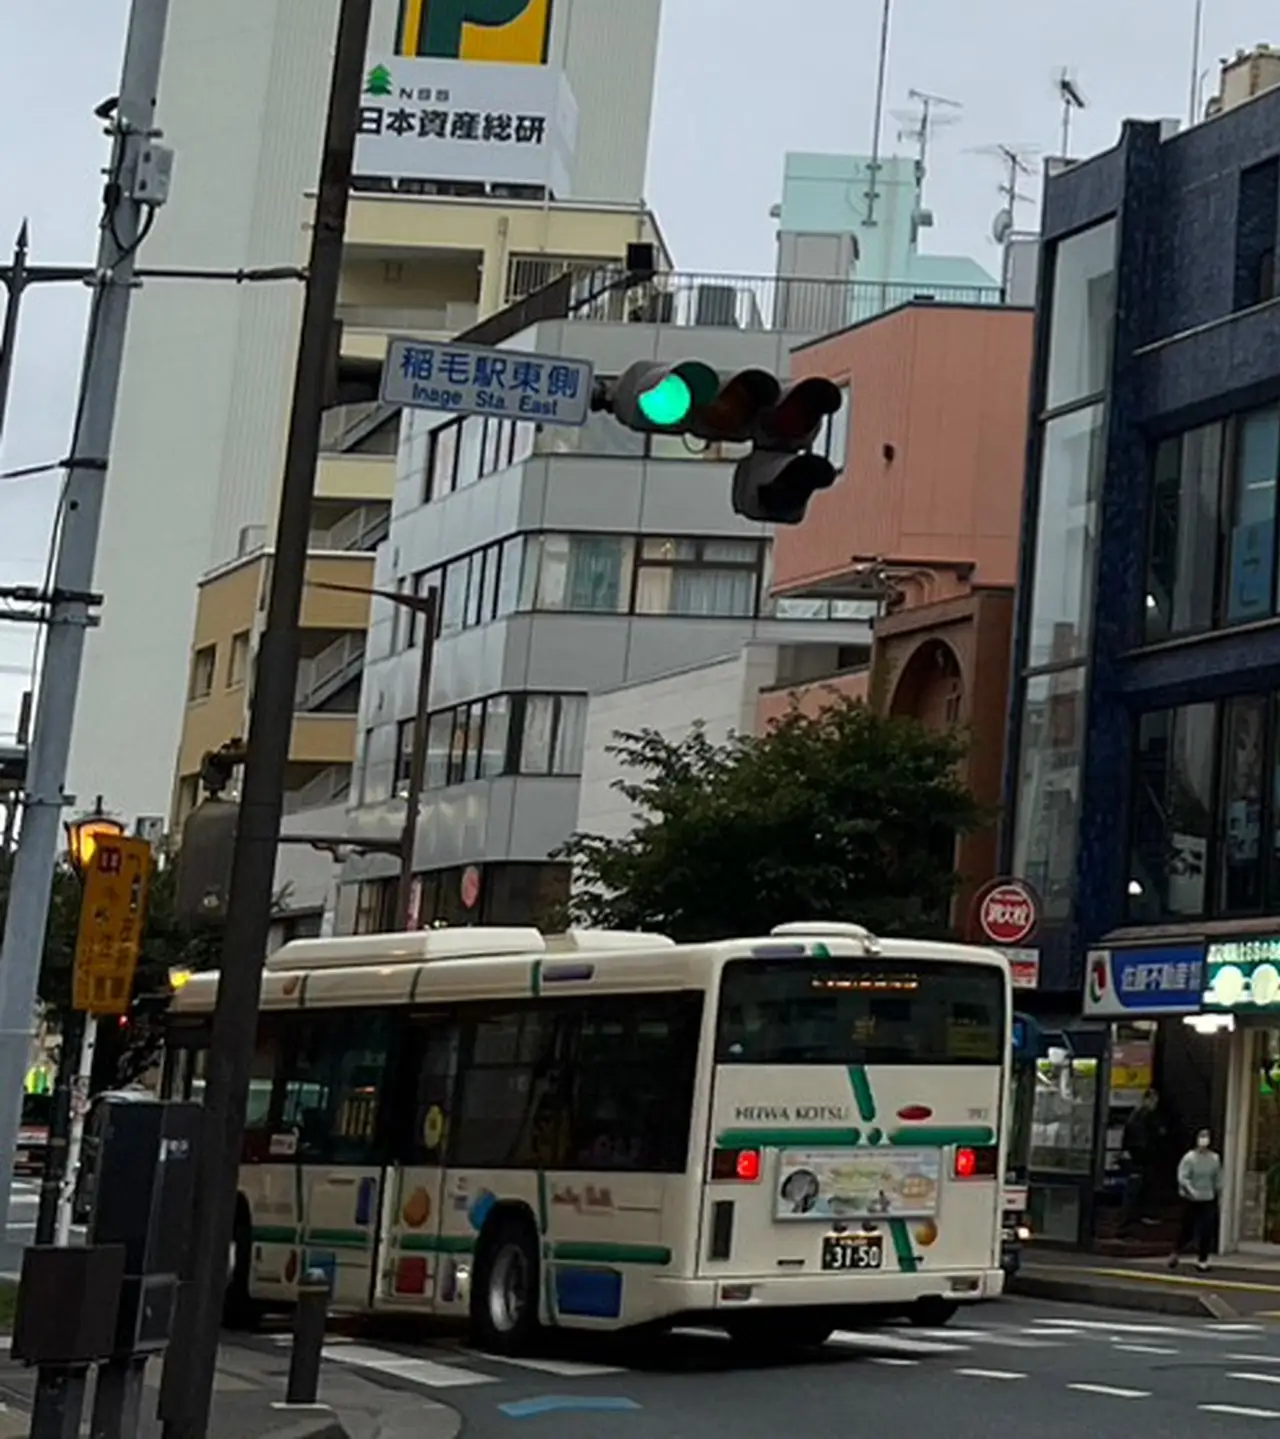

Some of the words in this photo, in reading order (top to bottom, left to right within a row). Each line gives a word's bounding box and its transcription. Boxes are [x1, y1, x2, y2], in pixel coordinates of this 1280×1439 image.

[356, 107, 546, 144] 日本資産総研
[401, 346, 580, 399] 稲毛駅東側
[412, 382, 462, 407] Inage
[518, 396, 558, 416] East
